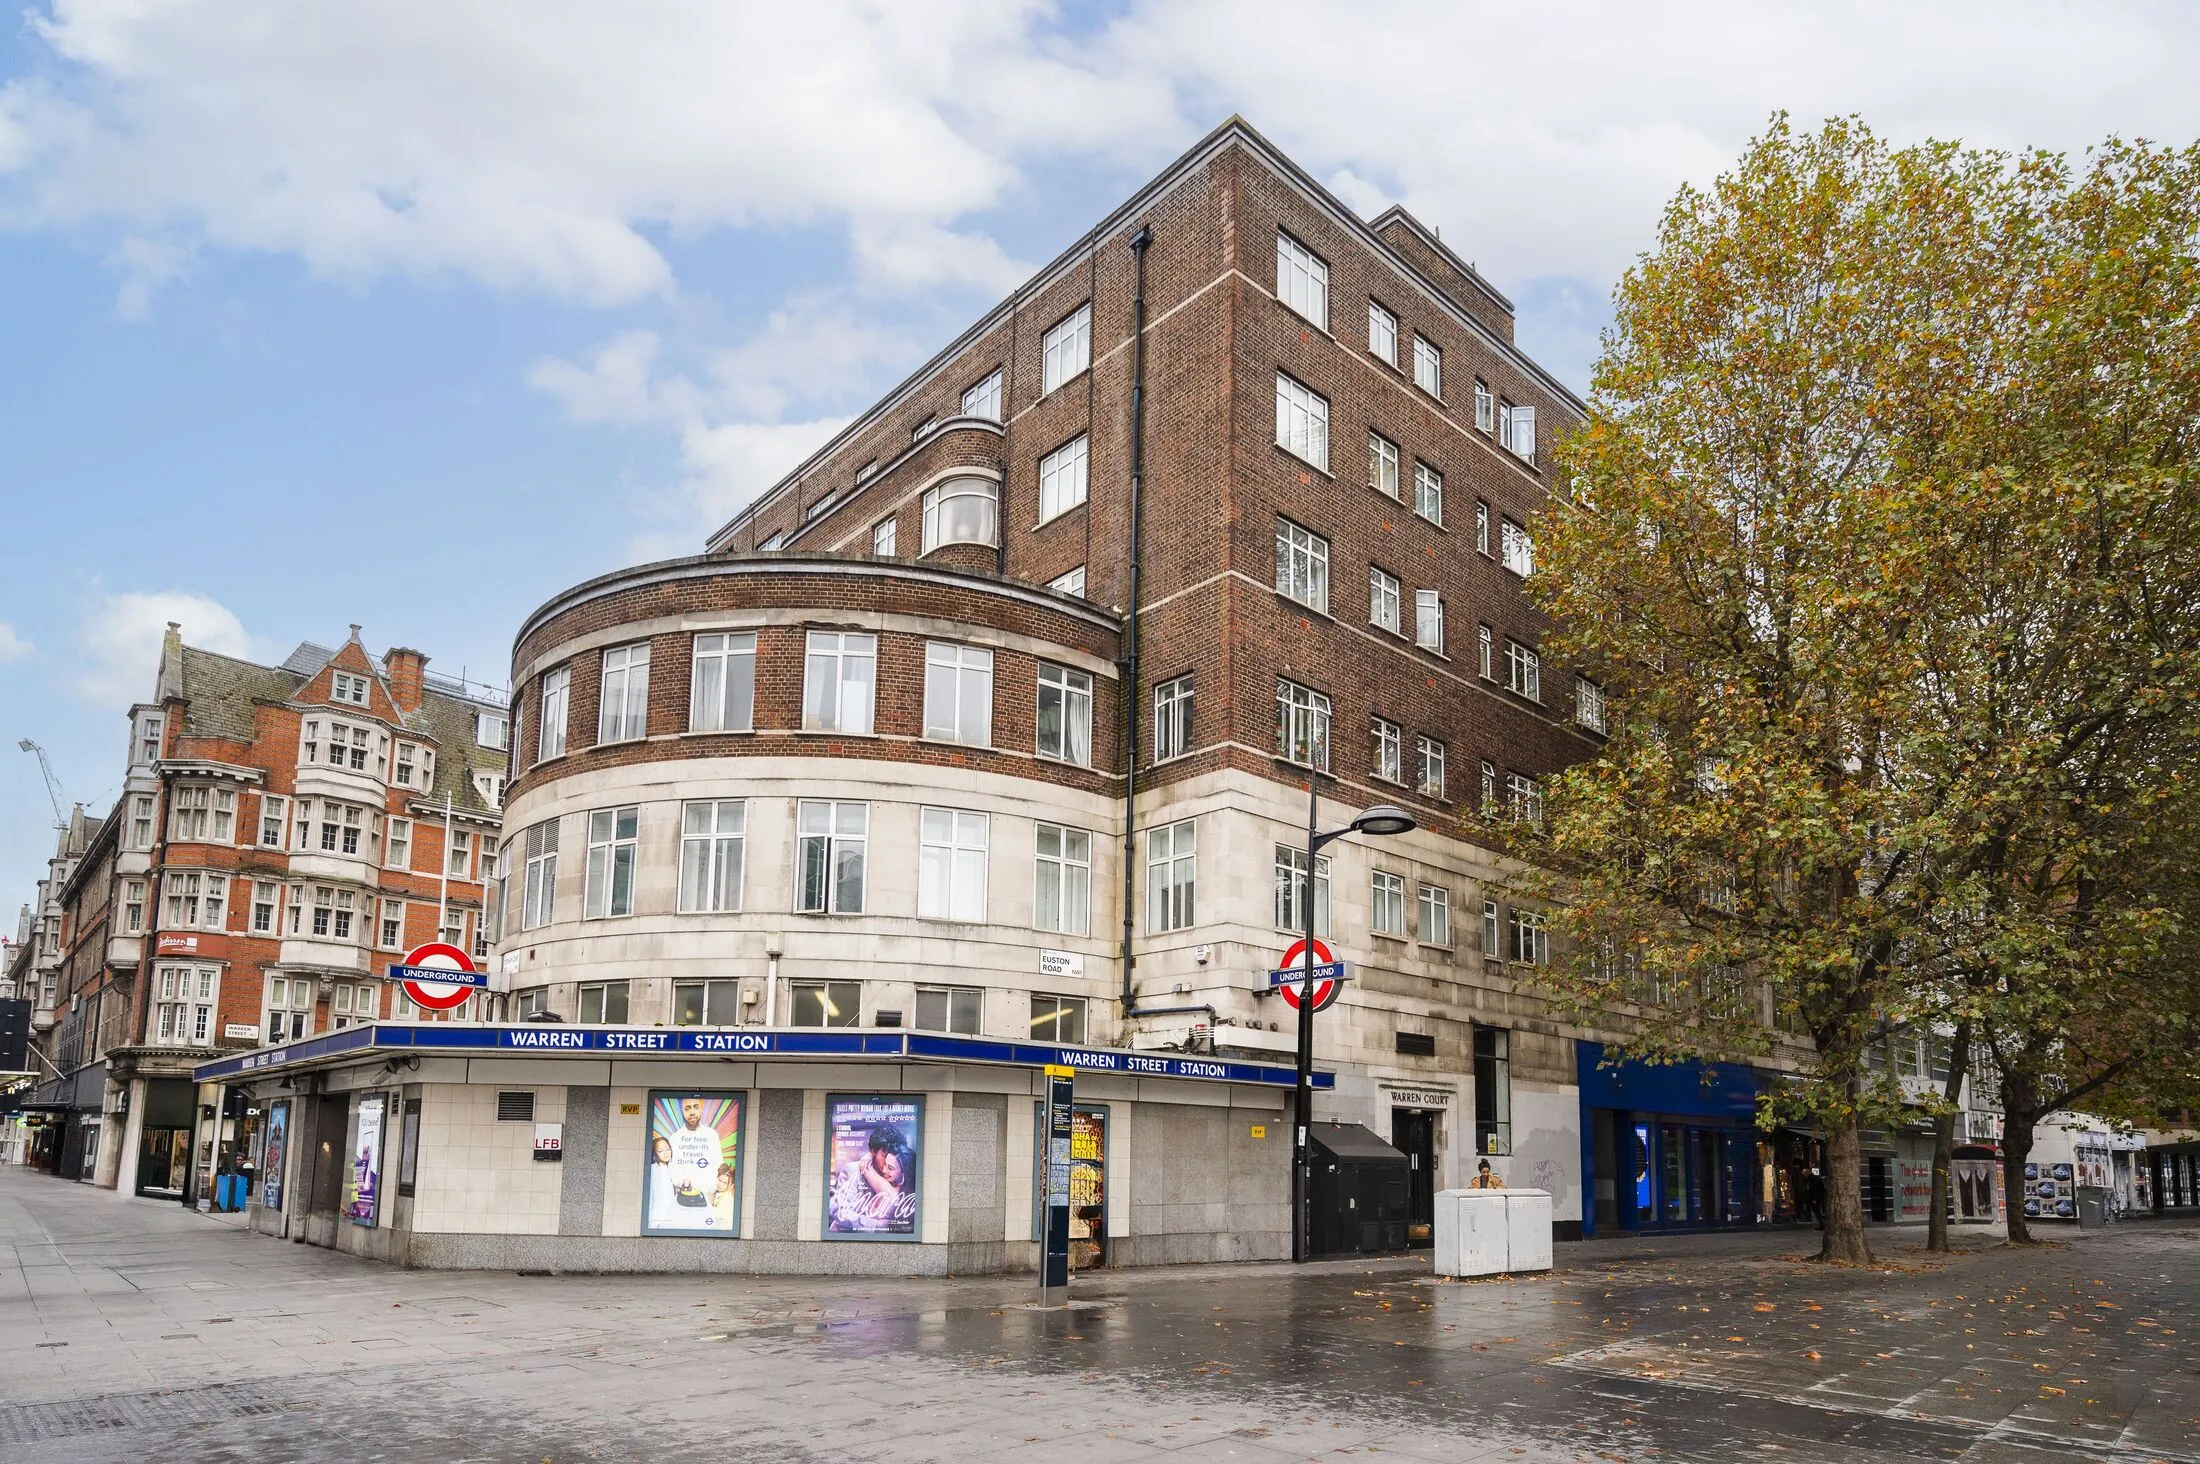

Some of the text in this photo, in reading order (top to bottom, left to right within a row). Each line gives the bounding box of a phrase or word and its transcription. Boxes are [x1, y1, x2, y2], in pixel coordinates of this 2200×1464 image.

[1042, 955, 1070, 966] EUSTON
[403, 968, 475, 983] UNDERGROUND
[1042, 964, 1063, 973] ROAD
[1279, 967, 1335, 982] UNDEROUND
[511, 1031, 768, 1050] WARREN STREET STATION
[1061, 1051, 1226, 1078] WARREN STREET STATION
[1391, 1091, 1450, 1106] WARREN COURT
[535, 1138, 560, 1149] LFB
[681, 1135, 708, 1143] For free
[828, 1174, 916, 1222] Anora
